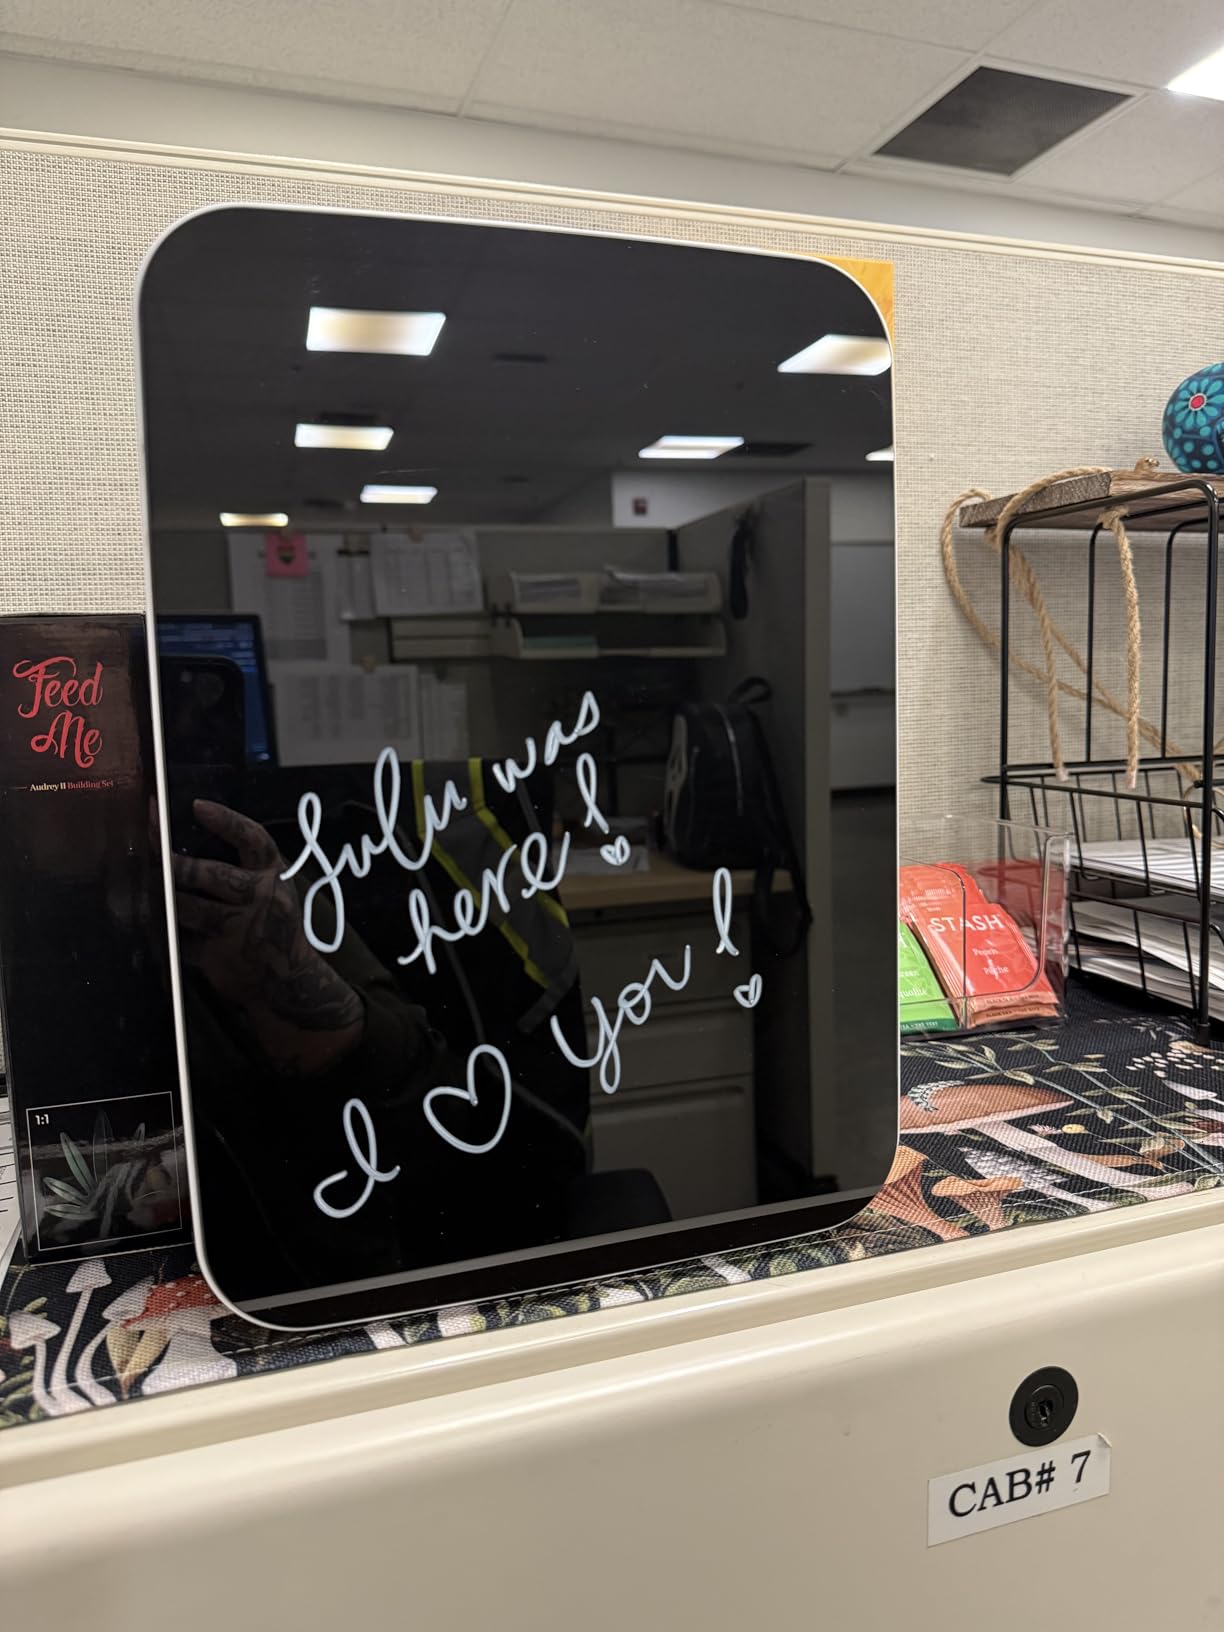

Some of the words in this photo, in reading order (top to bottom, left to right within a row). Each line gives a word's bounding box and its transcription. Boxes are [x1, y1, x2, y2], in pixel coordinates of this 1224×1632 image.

[12, 656, 104, 719] Feed
[30, 709, 103, 769] Me
[492, 690, 600, 794] was
[30, 782, 59, 792] Audrey
[67, 780, 100, 790] Building
[927, 914, 1005, 933] STASH
[35, 1113, 50, 1126] 1:1
[948, 1459, 1056, 1518] CAB#
[1070, 1450, 1091, 1484] 7
